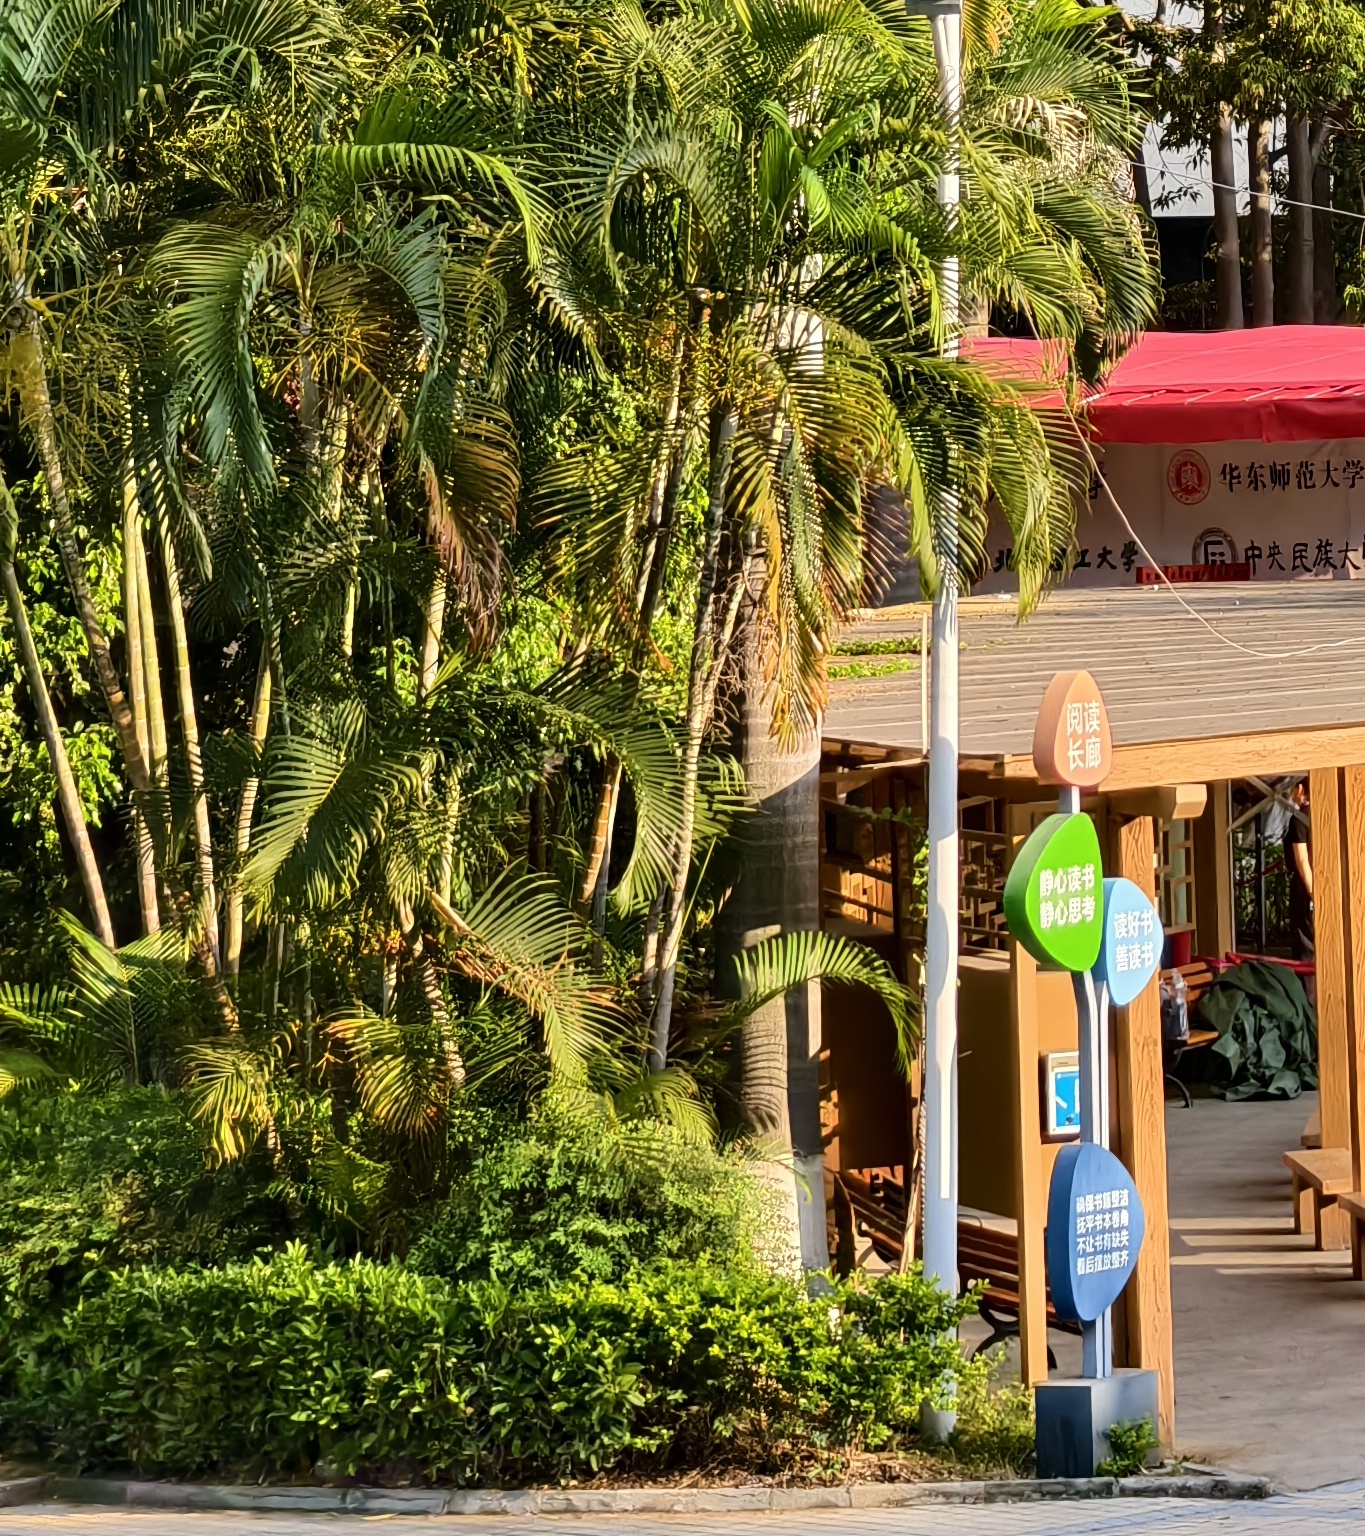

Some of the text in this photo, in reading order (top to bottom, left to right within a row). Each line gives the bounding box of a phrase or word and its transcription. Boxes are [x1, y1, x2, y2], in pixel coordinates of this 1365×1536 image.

[1219, 459, 1365, 493] 华东师范大学
[1066, 700, 1101, 736] 阅读
[1067, 735, 1101, 771] 长廊
[1039, 863, 1096, 898] 静心读书
[1039, 894, 1096, 930] 静心思考
[1114, 909, 1154, 940] 读好书
[1115, 942, 1154, 974] 善读书
[1076, 1230, 1130, 1255] 不让书有缺失
